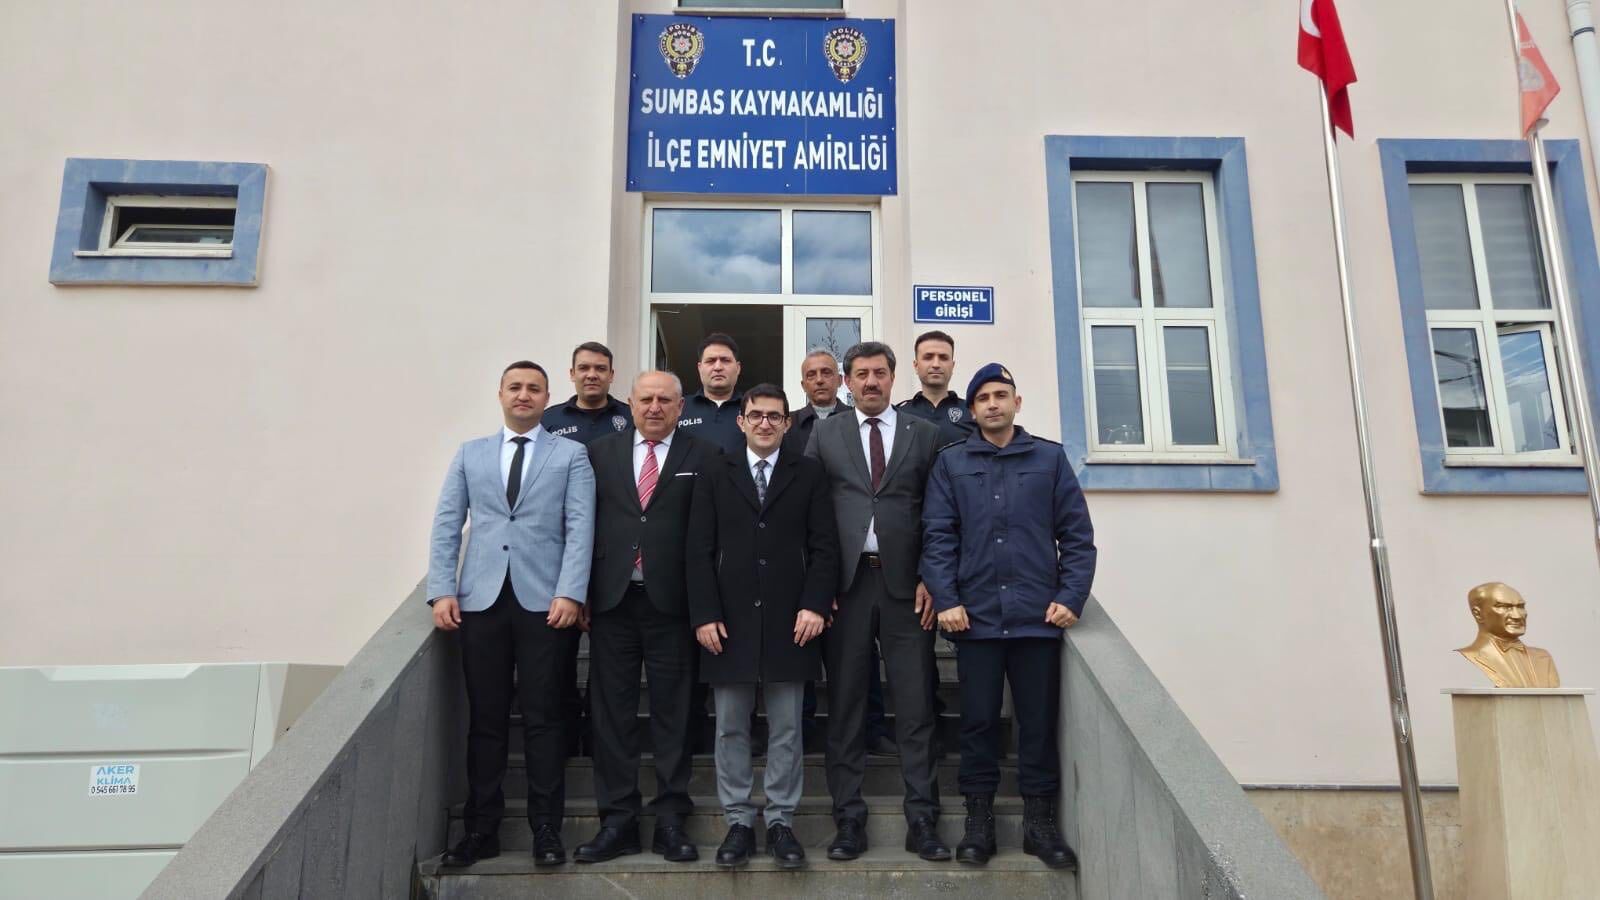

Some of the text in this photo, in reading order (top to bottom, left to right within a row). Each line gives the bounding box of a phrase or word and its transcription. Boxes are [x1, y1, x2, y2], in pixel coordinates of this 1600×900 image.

[641, 88, 883, 119] SUMBAS KAYMAKAMLIĞI
[647, 131, 887, 172] İLÇE EMNİYET AMİRLİĞİ
[921, 290, 987, 302] PERSONEL
[935, 304, 973, 318] GİRİŞİ
[96, 765, 135, 775] AKER
[96, 775, 132, 785] KLİMA
